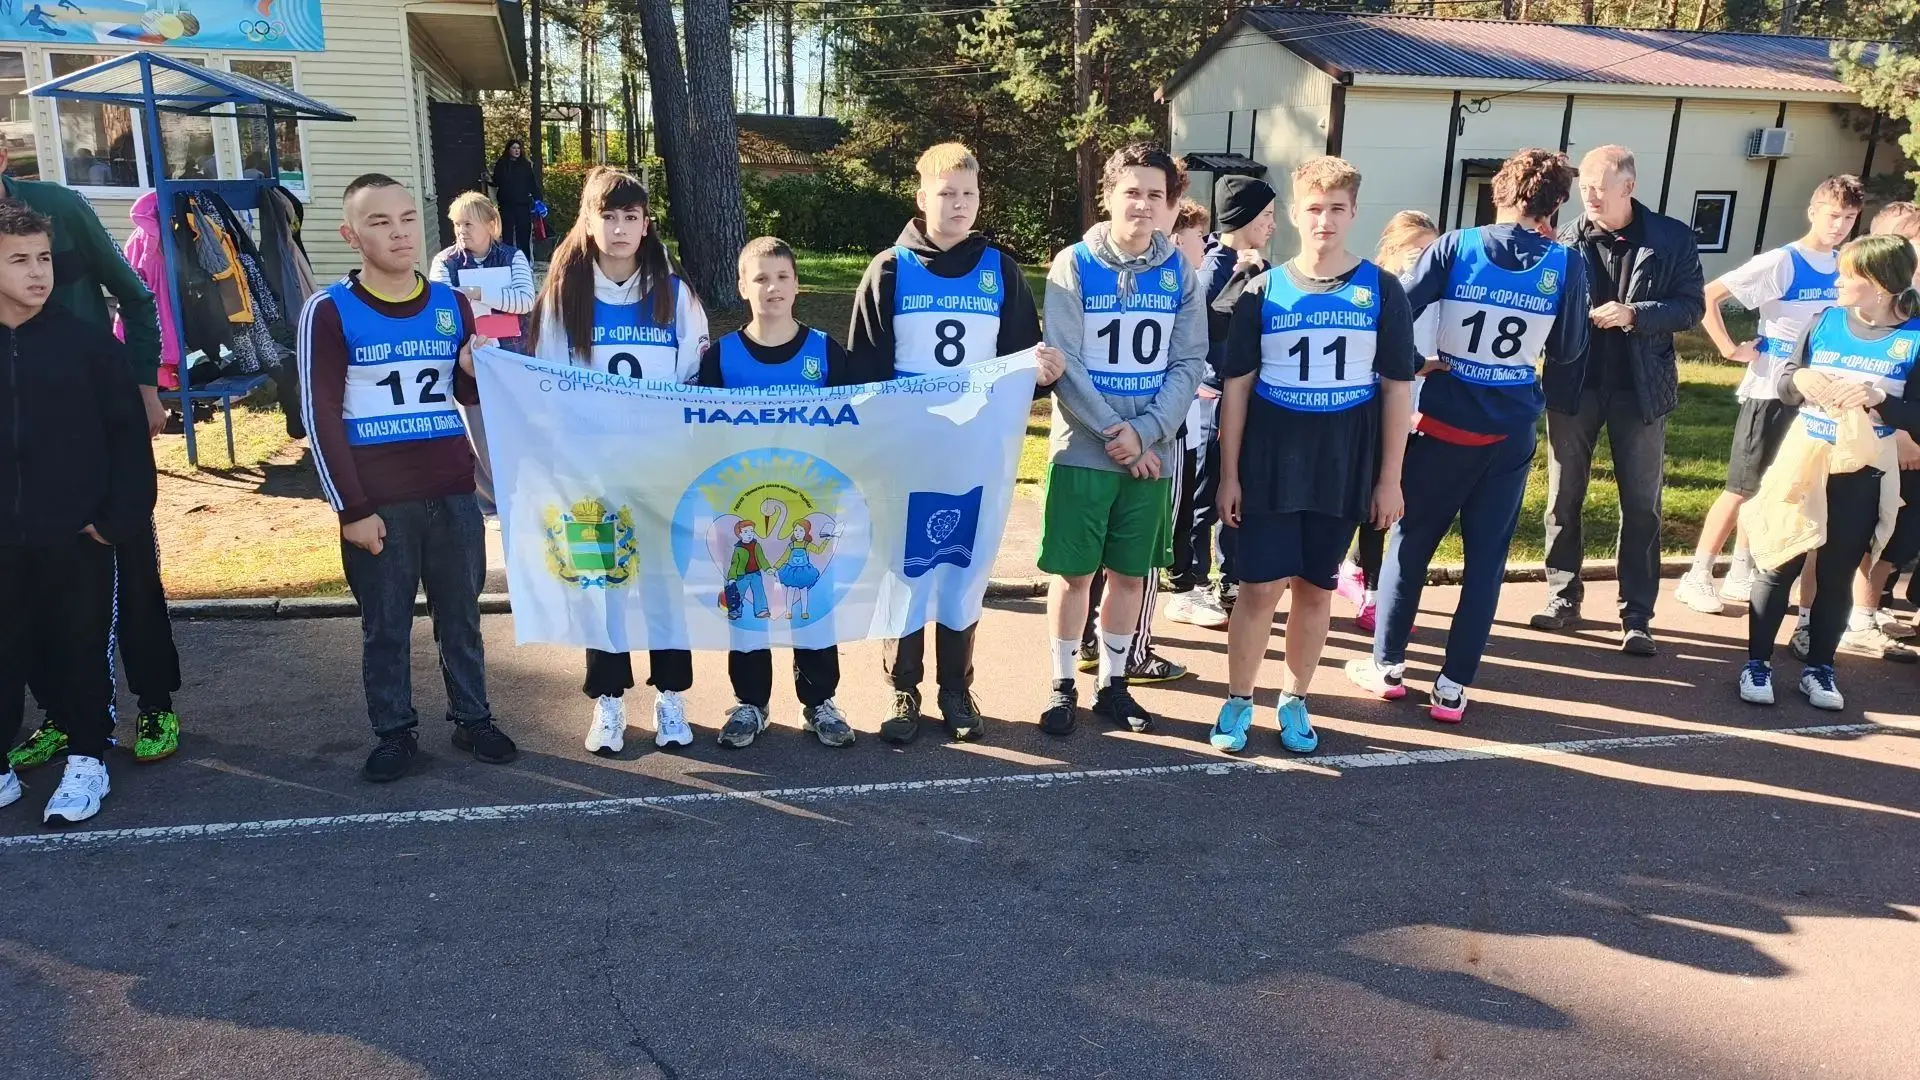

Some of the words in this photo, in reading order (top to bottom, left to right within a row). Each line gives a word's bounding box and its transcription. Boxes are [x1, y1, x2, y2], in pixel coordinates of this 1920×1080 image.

[902, 295, 934, 311] СШОР
[937, 295, 999, 313] «ОРЛЕНОК»
[1126, 293, 1178, 310] ОРЛЕНОК»
[1455, 284, 1487, 300] СШОР
[1489, 289, 1553, 312] «ОРЛЕНОК»
[1271, 312, 1303, 330] СШОР
[1306, 311, 1373, 327] «ОРЛЕНОК»
[608, 326, 672, 344] «ОРЛЕНОК»
[934, 319, 966, 367] 8
[1097, 318, 1162, 365] 10
[1462, 309, 1528, 359] 18
[355, 343, 391, 363] СШОР
[394, 340, 458, 358] «ОРЛЕНОК»
[1288, 335, 1347, 382] 11
[376, 367, 447, 405] 12
[357, 416, 432, 438] КАЛУЖСКАЯ
[433, 413, 464, 431] ОБЛАС
[684, 403, 860, 427] НАДЕЖДА
